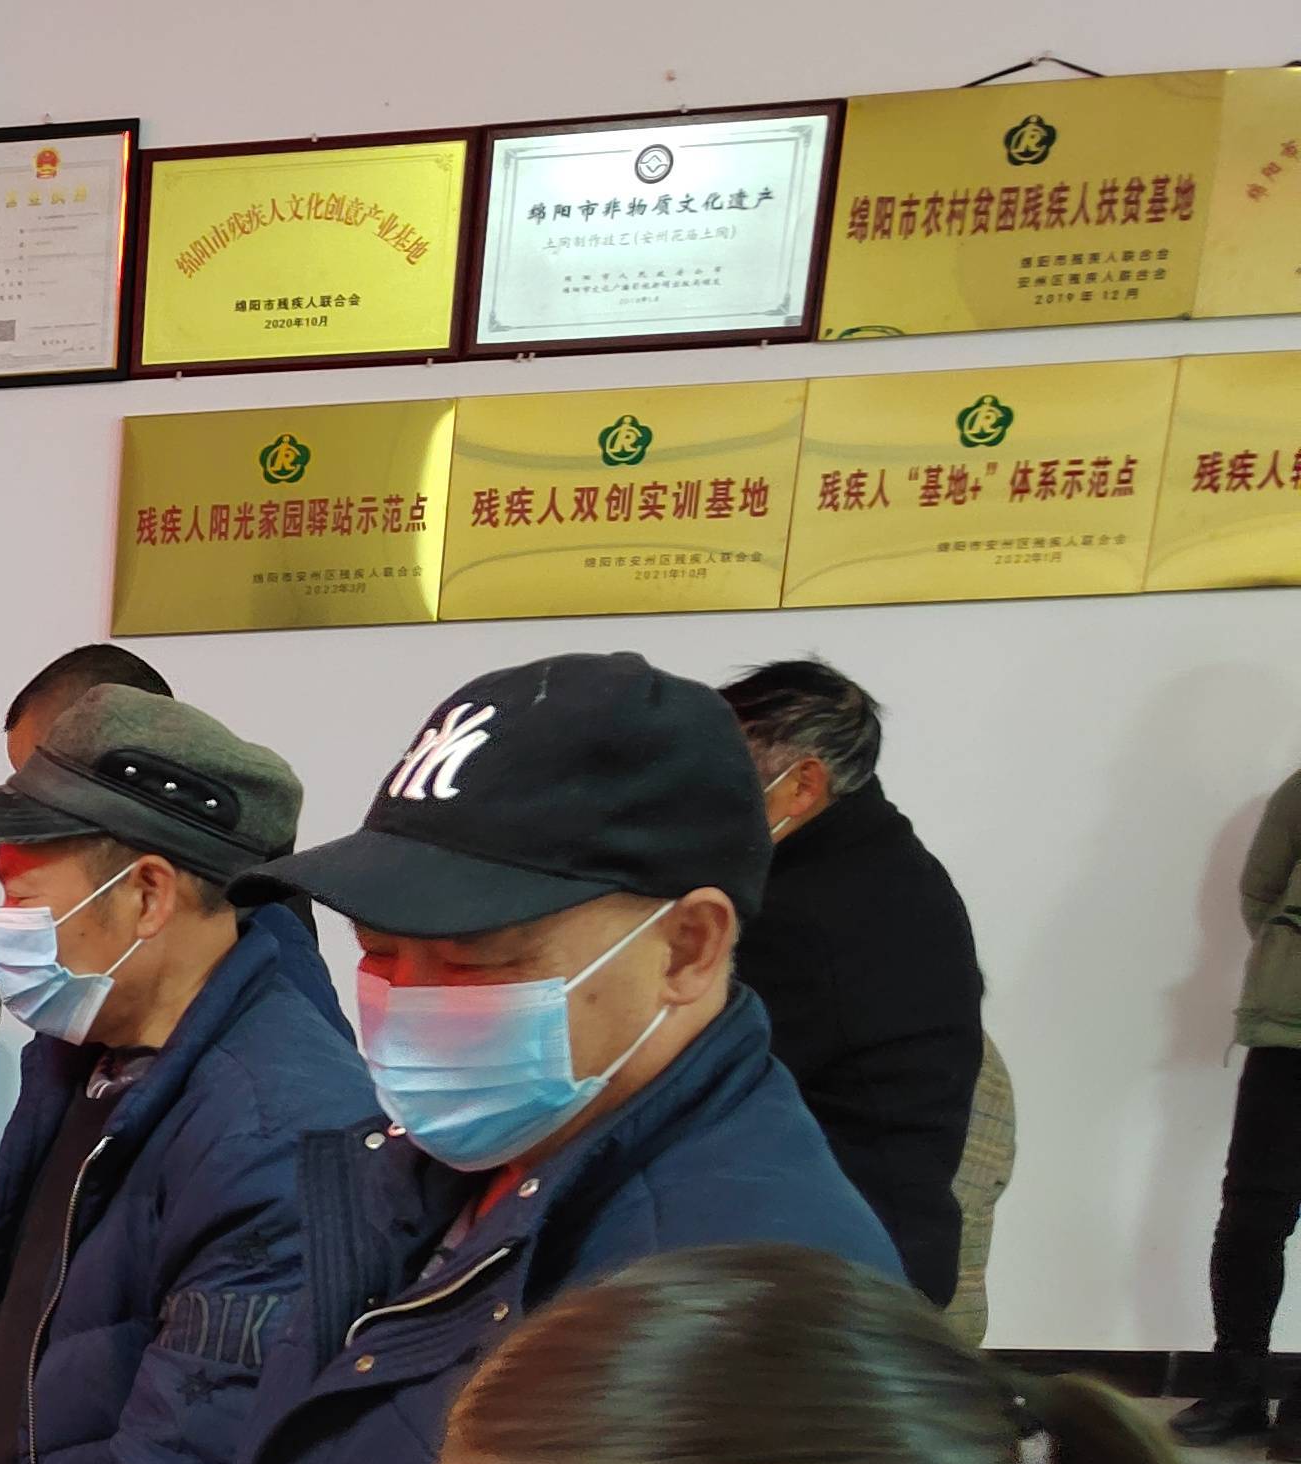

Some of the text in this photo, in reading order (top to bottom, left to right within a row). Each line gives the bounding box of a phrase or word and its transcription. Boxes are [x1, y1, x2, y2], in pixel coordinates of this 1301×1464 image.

[527, 187, 775, 225] 绵阳市非物质文化遗产
[846, 173, 1196, 244] 绵阳市农村贫困残疾人扶贫基地
[175, 191, 431, 279] 绵阳市残疾人文化创意产业基地
[1019, 248, 1169, 269] 绵阳市残疾人联合会
[1017, 267, 1167, 288] 安州区残疾人联合会
[234, 293, 361, 313] 绵阳市残疾人联合会
[264, 315, 329, 329] 2020年10月
[471, 477, 770, 529] 残疾人双创实训基地
[136, 492, 428, 546] 残疾人阳光家园驿站示范点
[584, 551, 763, 568] 绵阳市安州区残疾人联合会
[252, 565, 423, 584] 绵阳市安州区残疾人联合会
